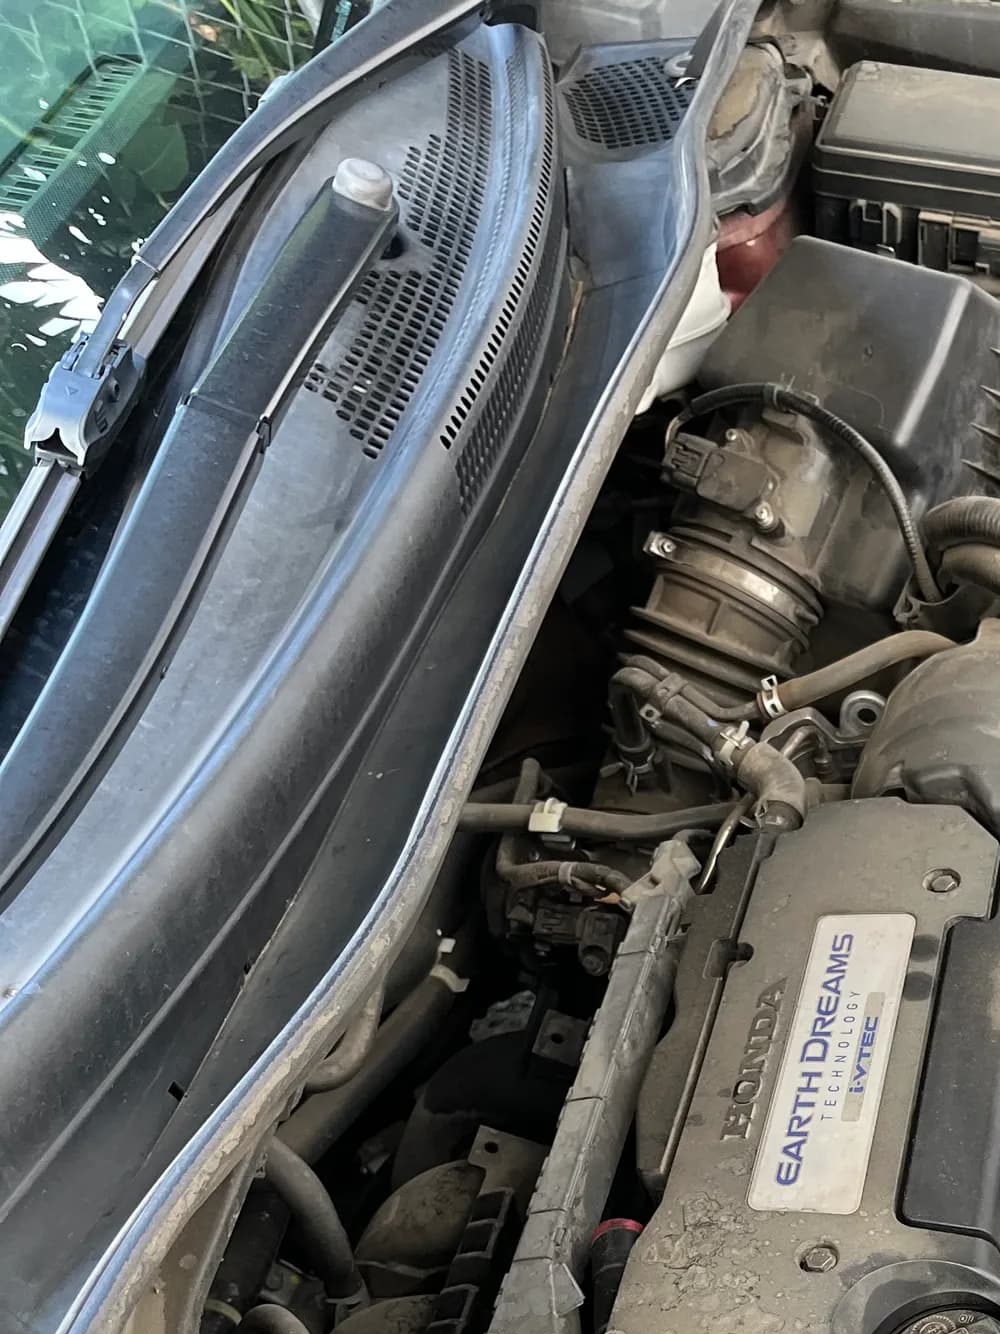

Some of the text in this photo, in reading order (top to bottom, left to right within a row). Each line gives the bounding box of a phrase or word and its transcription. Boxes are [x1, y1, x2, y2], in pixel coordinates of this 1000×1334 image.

[720, 976, 788, 1142] HONDA
[776, 932, 855, 1187] EARTH DREAMS
[820, 989, 861, 1122] TECHNOLOGY
[848, 1015, 880, 1095] i-VTEC
